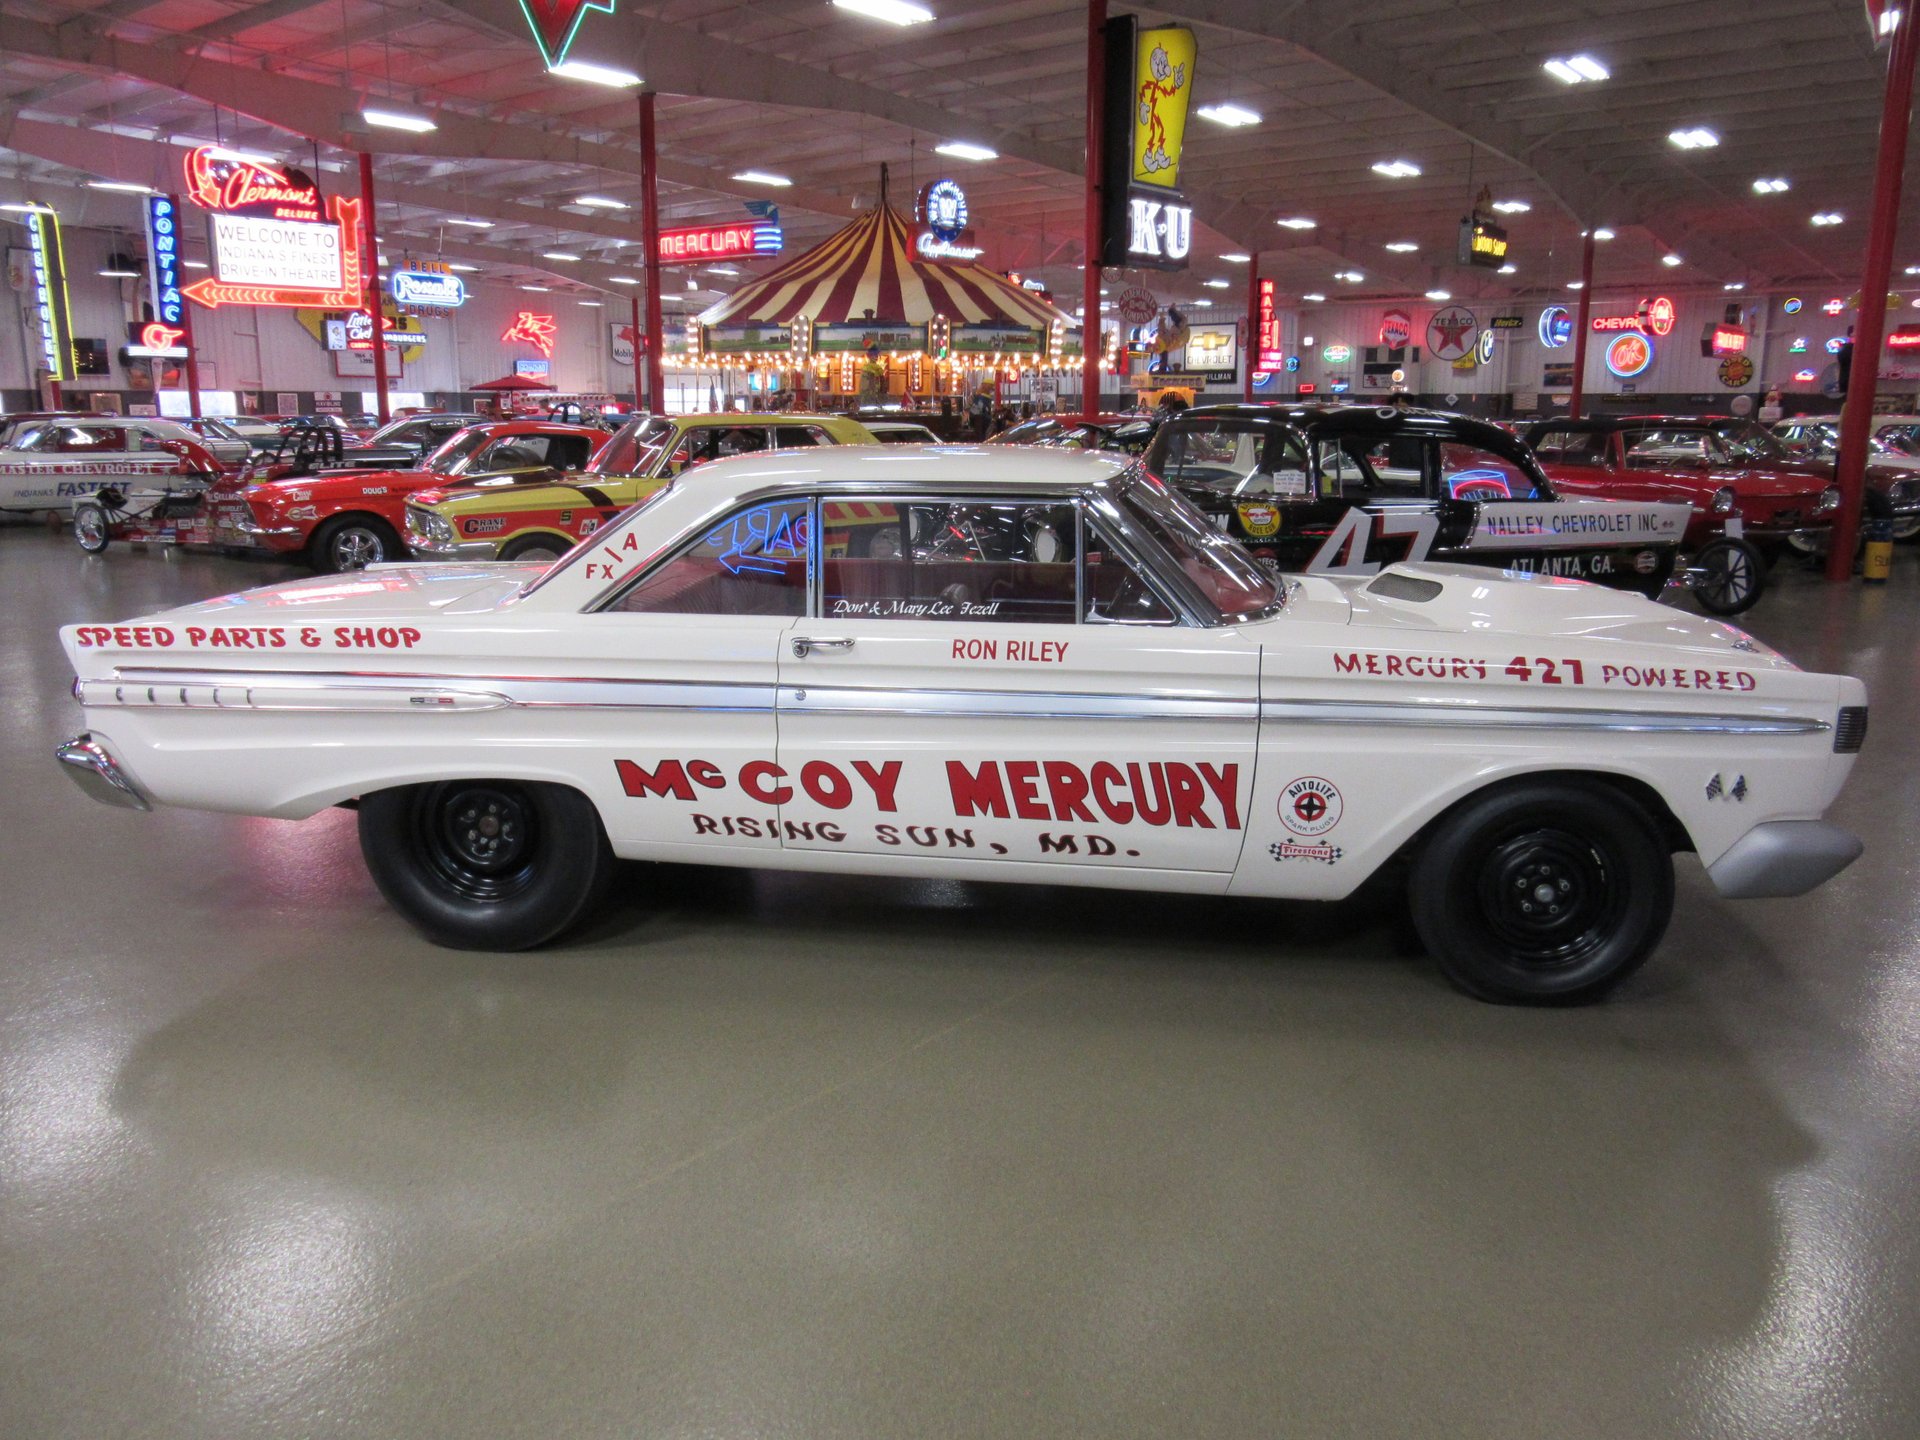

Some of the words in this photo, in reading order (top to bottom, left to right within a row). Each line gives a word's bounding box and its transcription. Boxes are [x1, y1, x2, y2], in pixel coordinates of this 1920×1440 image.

[224, 168, 316, 208] Clermont
[275, 207, 318, 220] DELUXE
[218, 224, 307, 246] WELCOME
[314, 232, 336, 249] TO
[660, 230, 751, 255] MERCURY
[155, 201, 181, 322] PONTIAC
[291, 250, 336, 265] FINEST
[410, 261, 446, 274] BELL
[220, 263, 278, 278] DRIVE-IN
[282, 267, 337, 282] THEATRE
[346, 311, 373, 328] Little
[409, 305, 450, 317] DRUGS
[1384, 320, 1409, 337] TEXACO
[1434, 317, 1473, 326] TEXACO
[1186, 354, 1233, 364] CHEVROLET
[60, 463, 154, 475] CHEVROLET
[1487, 515, 1544, 535] NALLEY
[1552, 514, 1632, 534] CHEVROLET
[1638, 513, 1658, 532] INC
[1304, 505, 1440, 577] 47
[1510, 557, 1587, 577] ATLANTA,
[1591, 555, 1615, 574] GA.
[869, 601, 881, 616] &
[884, 601, 929, 617] Mary
[927, 601, 954, 616] Lee
[77, 627, 175, 648] SPEED
[185, 627, 286, 649] PARTS
[300, 627, 322, 648] &
[334, 627, 422, 648] SHOP
[952, 639, 997, 660] RON
[1006, 641, 1069, 662] RILEY
[1333, 652, 1486, 680] MERCURY
[1505, 656, 1584, 685] 427
[1603, 664, 1756, 692] POWERED
[945, 760, 1241, 830] MERCURY
[1288, 780, 1336, 801] AUTOLITE
[1285, 814, 1308, 832] SPARK
[1310, 816, 1335, 833] PLUGS
[689, 813, 848, 845] RISING
[1038, 832, 1142, 857] MD.
[1283, 846, 1329, 856] Firestone
